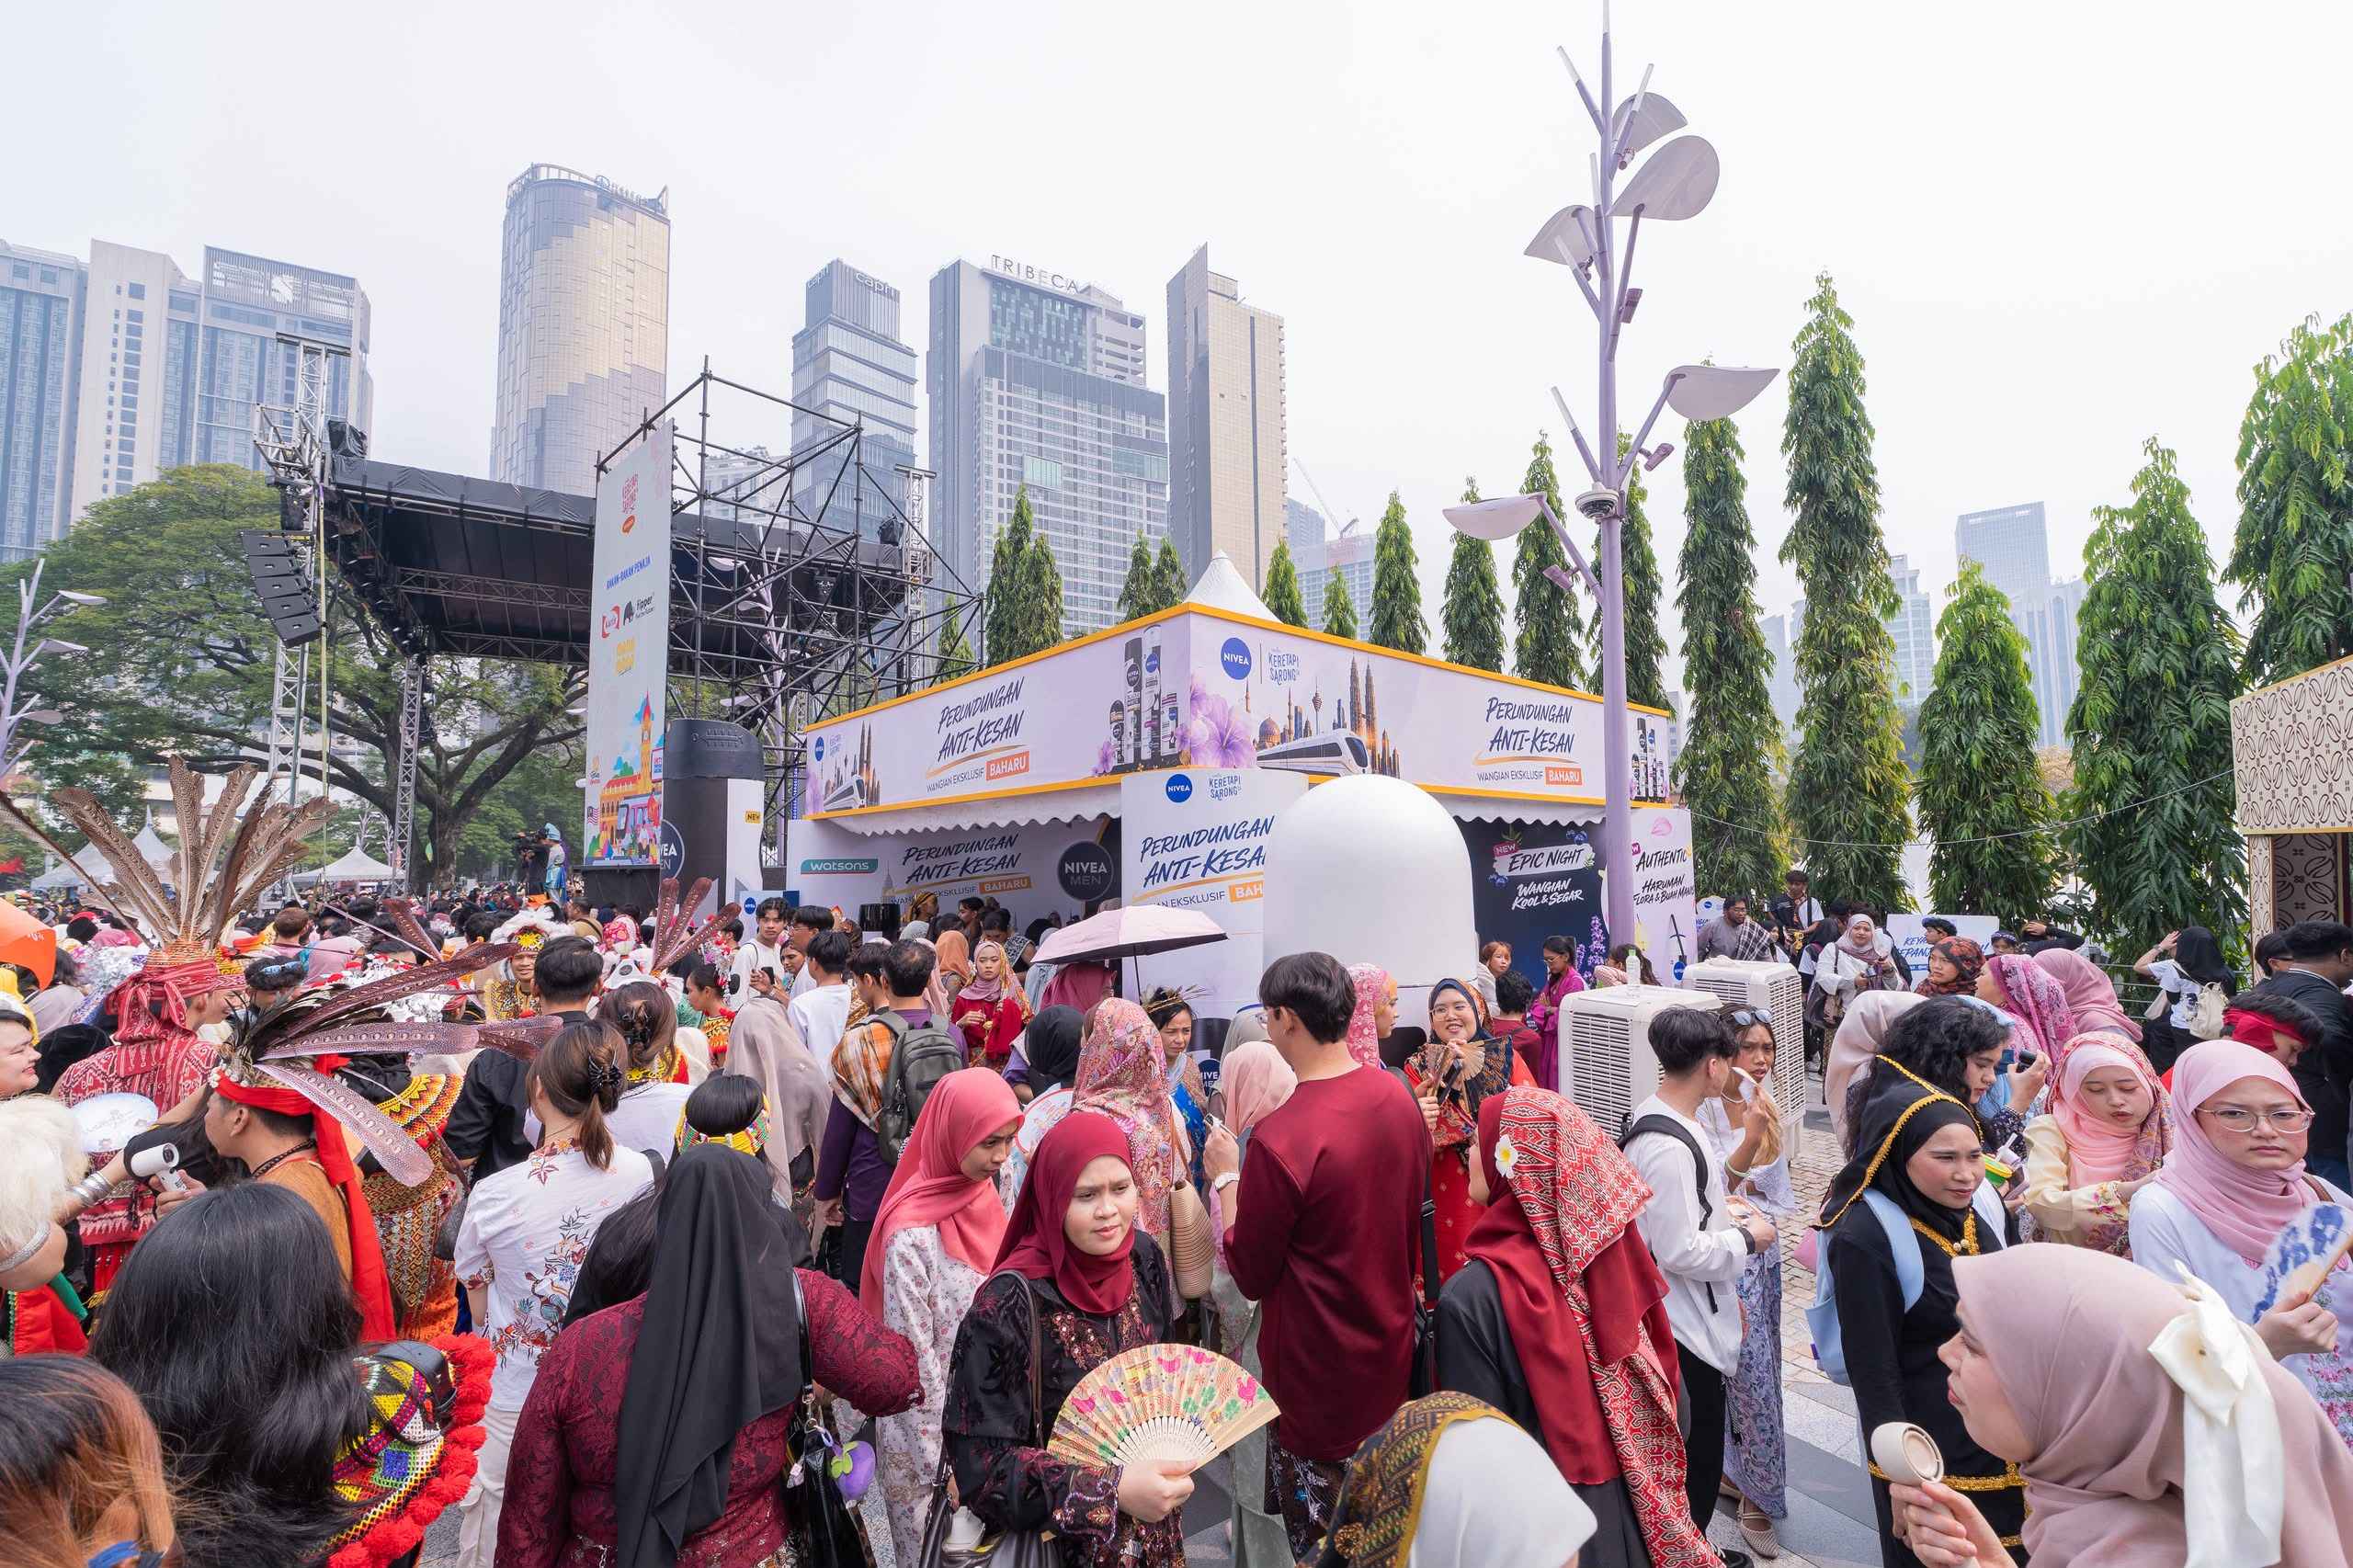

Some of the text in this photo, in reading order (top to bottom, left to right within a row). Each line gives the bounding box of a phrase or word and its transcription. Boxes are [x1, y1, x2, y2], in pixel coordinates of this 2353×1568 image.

[992, 255, 1079, 293] TRIBECA
[1223, 653, 1250, 665] NIVEA
[1268, 653, 1300, 667] KERETAPI
[1270, 668, 1297, 686] SARONG
[938, 676, 1025, 734] PERLINDUNGAN
[1485, 697, 1573, 723] PERLINDUNGAN
[938, 710, 1025, 762] ANTI-KESAN
[1489, 725, 1575, 754] ANTI-KESAN
[926, 756, 1026, 792] WANGIAN EKSKLUSIF BAHARU
[1209, 775, 1241, 788] KERETAPI
[1477, 770, 1580, 782] WANGIAN EKSKLUSIF BAHARU
[1210, 786, 1238, 801] SARONG
[1140, 815, 1275, 862] PERLINDUNGAN
[902, 832, 1019, 865] PERLINDUNGAN
[1495, 844, 1516, 855] NEW
[811, 860, 869, 870] watsons
[905, 852, 1022, 883] ANTI-KESAN
[1065, 862, 1107, 873] NIVEA
[1508, 848, 1585, 872] EPIC NIGHT
[984, 880, 1028, 892] BAHARU
[1070, 875, 1101, 885] MEN
[1517, 878, 1572, 897] WANGIAN
[1642, 873, 1685, 893] HARUMAN
[1171, 882, 1263, 908] EKSKLUSIF BAH
[1511, 889, 1585, 910] KOOL & SEGAR
[1633, 892, 1654, 905] FLORA
[1654, 892, 1660, 902] &
